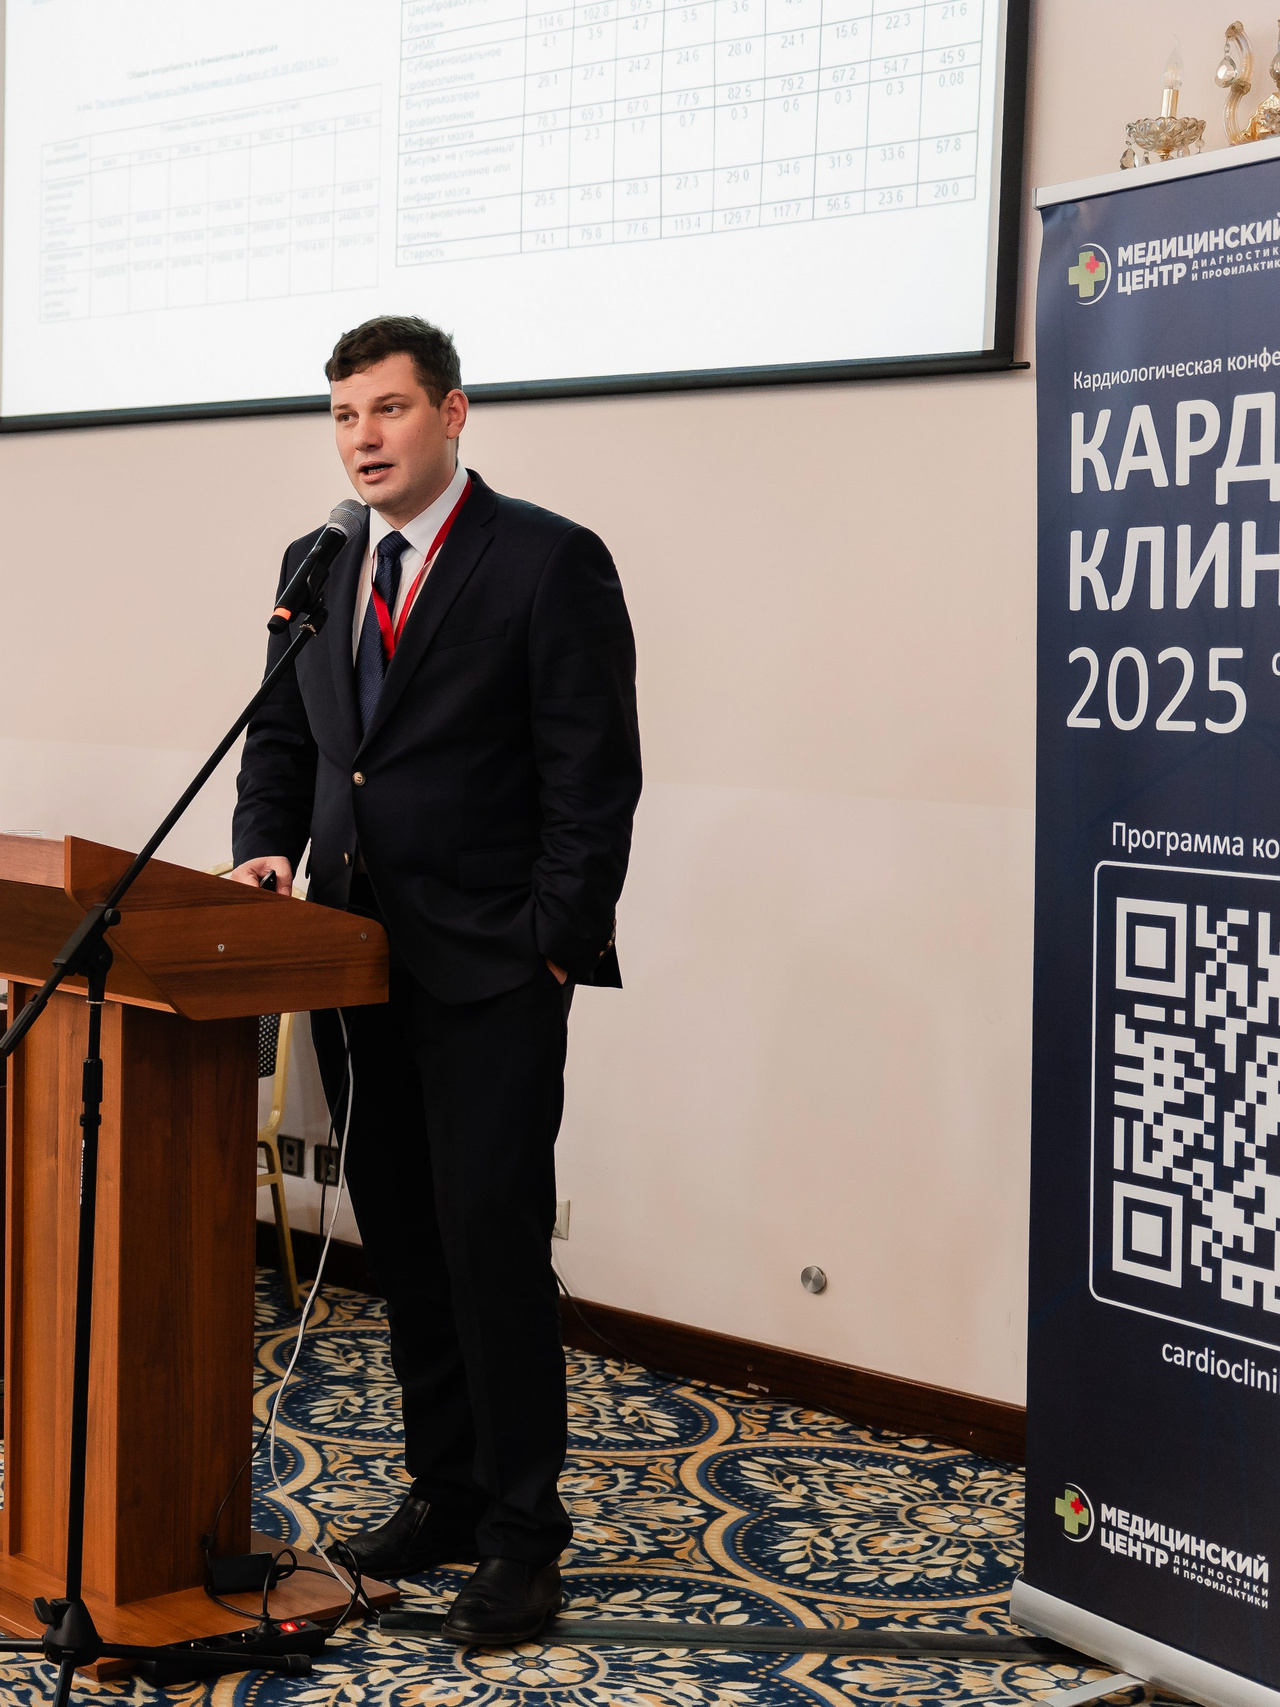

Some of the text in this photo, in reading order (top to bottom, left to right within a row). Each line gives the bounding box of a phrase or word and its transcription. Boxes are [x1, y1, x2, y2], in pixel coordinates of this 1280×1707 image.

[1117, 262, 1187, 296] ЦЕНТР
[1191, 272, 1198, 281] И
[1073, 358, 1222, 392] Кардиологическая
[1070, 390, 1280, 507] КАРД
[1068, 519, 1280, 612] КЛИН
[1066, 646, 1247, 734] 2025
[1111, 821, 1280, 859] Программа ко
[1100, 1527, 1169, 1569] ЦЕНТР
[1101, 1502, 1269, 1583] МЕДИЦИНСКИЙ
[1173, 1555, 1269, 1598] ДИАГНОСТИКИ
[1173, 1565, 1269, 1610] И ПРОФИЛАКТИКИ
